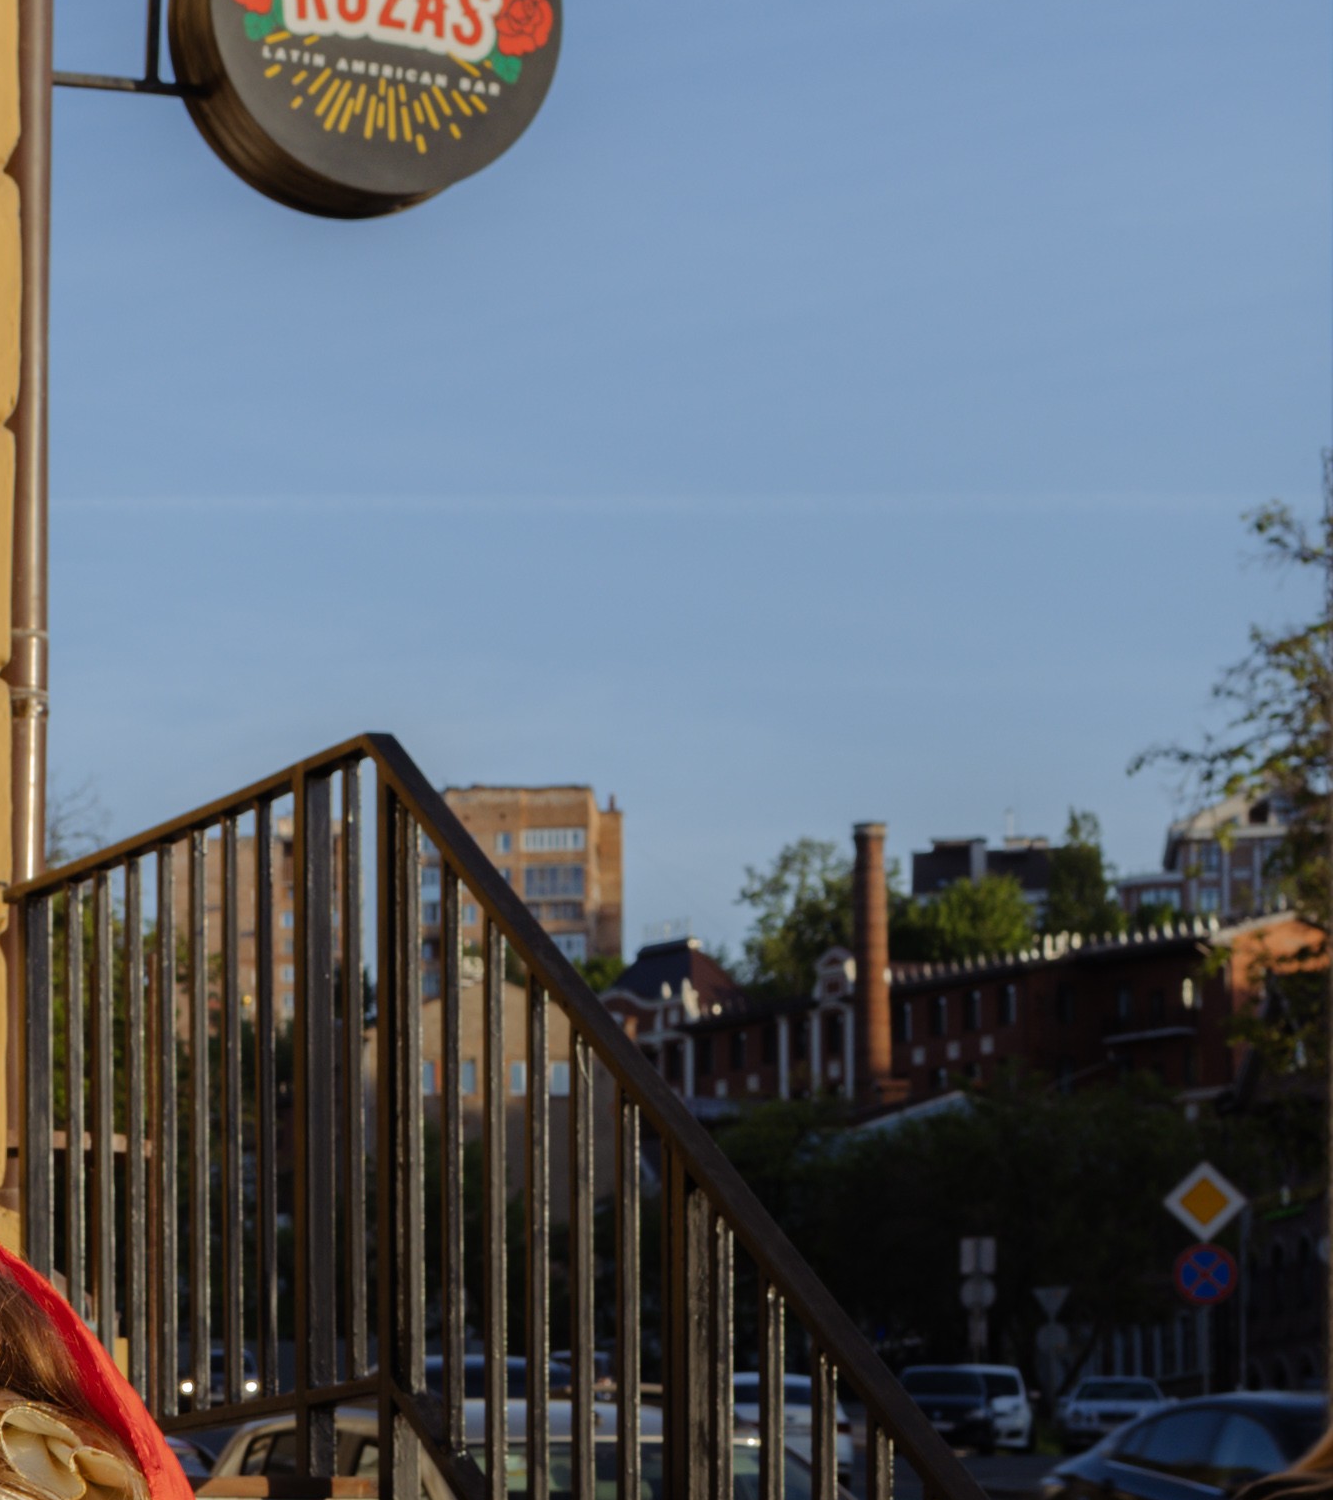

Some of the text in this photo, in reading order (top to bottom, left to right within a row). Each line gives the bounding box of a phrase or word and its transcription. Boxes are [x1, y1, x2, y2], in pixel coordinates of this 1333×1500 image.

[261, 45, 502, 97] LATIN AMERICAN BAR
